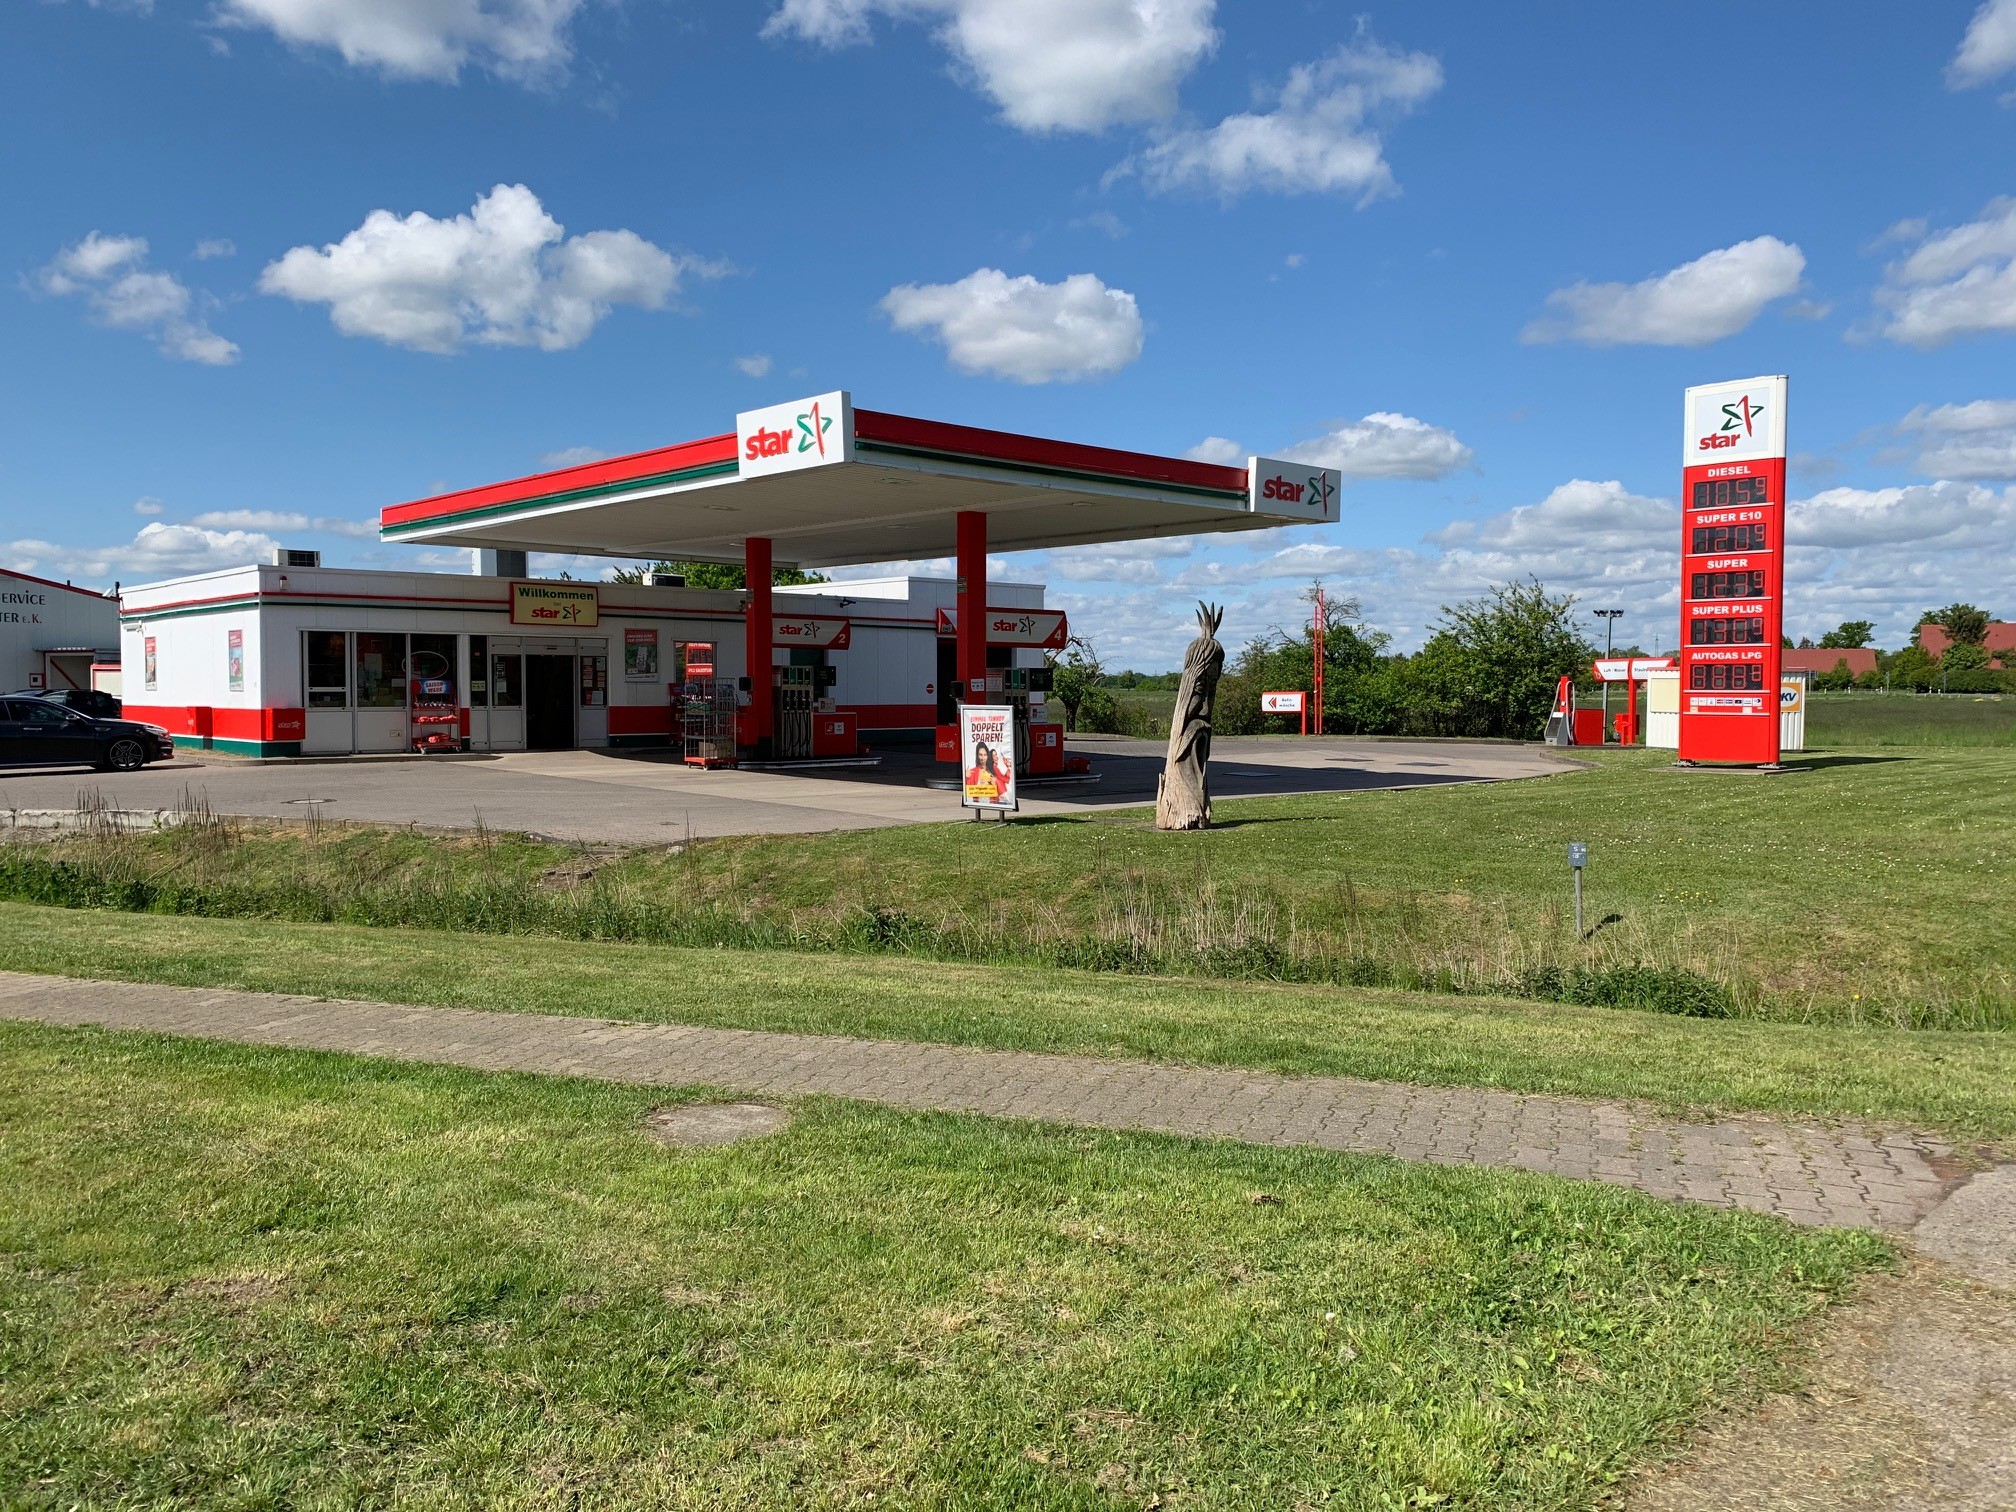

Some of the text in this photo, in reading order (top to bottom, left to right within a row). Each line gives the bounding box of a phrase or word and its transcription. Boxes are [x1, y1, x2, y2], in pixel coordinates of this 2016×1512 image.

[745, 416, 793, 460] star
[1699, 433, 1741, 450] star
[1708, 465, 1751, 478] DIESEL
[1262, 475, 1304, 502] star
[1697, 511, 1762, 524] SUPER E10
[1707, 558, 1748, 569] SUPER
[518, 587, 594, 600] Willkommen
[531, 606, 560, 618] star
[1692, 604, 1763, 615] SUPER PLUS
[779, 624, 802, 635] star
[992, 619, 1017, 632] star
[838, 633, 846, 644] 2
[1054, 630, 1062, 641] 4
[1691, 651, 1762, 660] AUTOGAS LPG
[1780, 692, 1797, 702] KV
[971, 722, 1004, 733] DOPPELT
[971, 733, 1003, 743] SPAREN!
